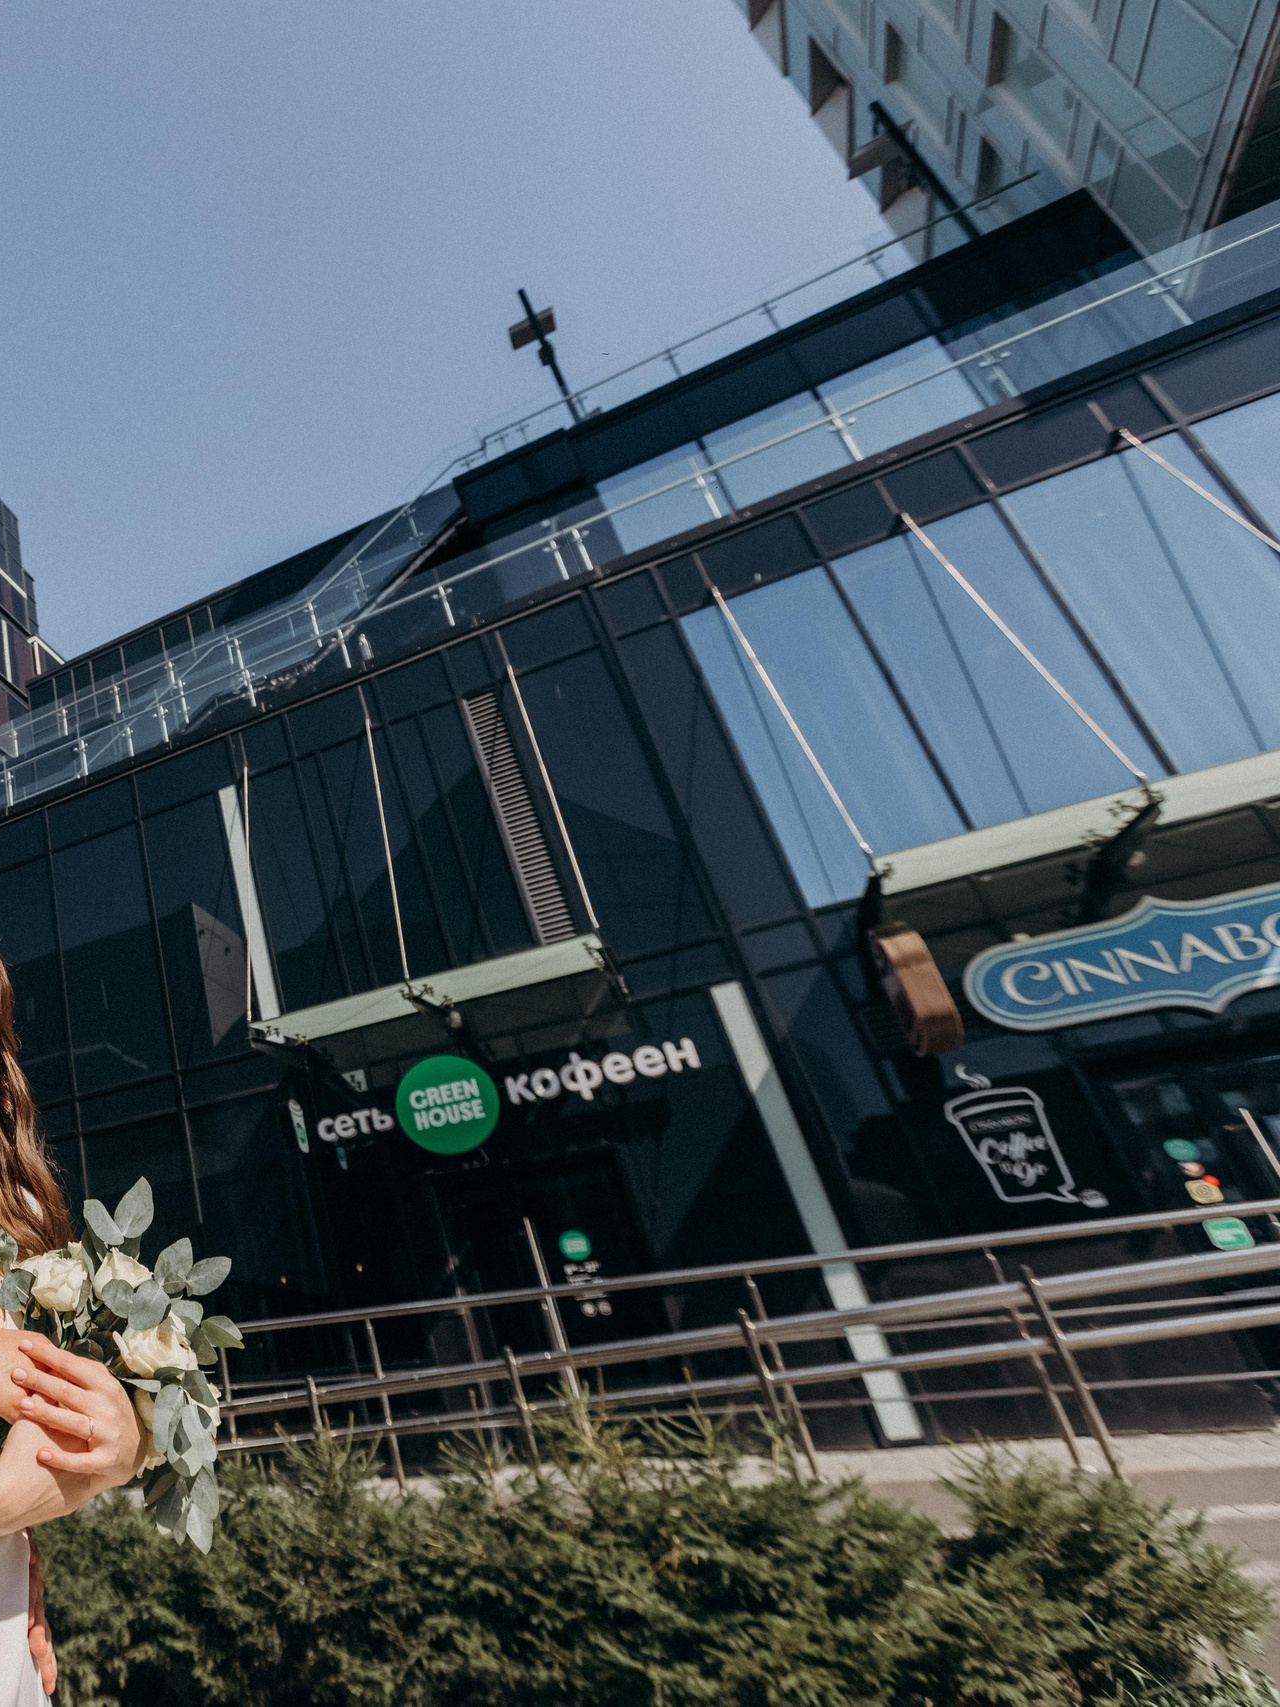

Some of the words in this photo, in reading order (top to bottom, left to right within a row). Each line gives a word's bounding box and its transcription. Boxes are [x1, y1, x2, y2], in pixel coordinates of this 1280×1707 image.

[504, 1037, 701, 1104] кофеен
[409, 1078, 480, 1110] GREEN
[317, 1107, 395, 1142] сеть
[414, 1100, 486, 1131] HOUSE
[979, 1131, 1048, 1164] Coffee
